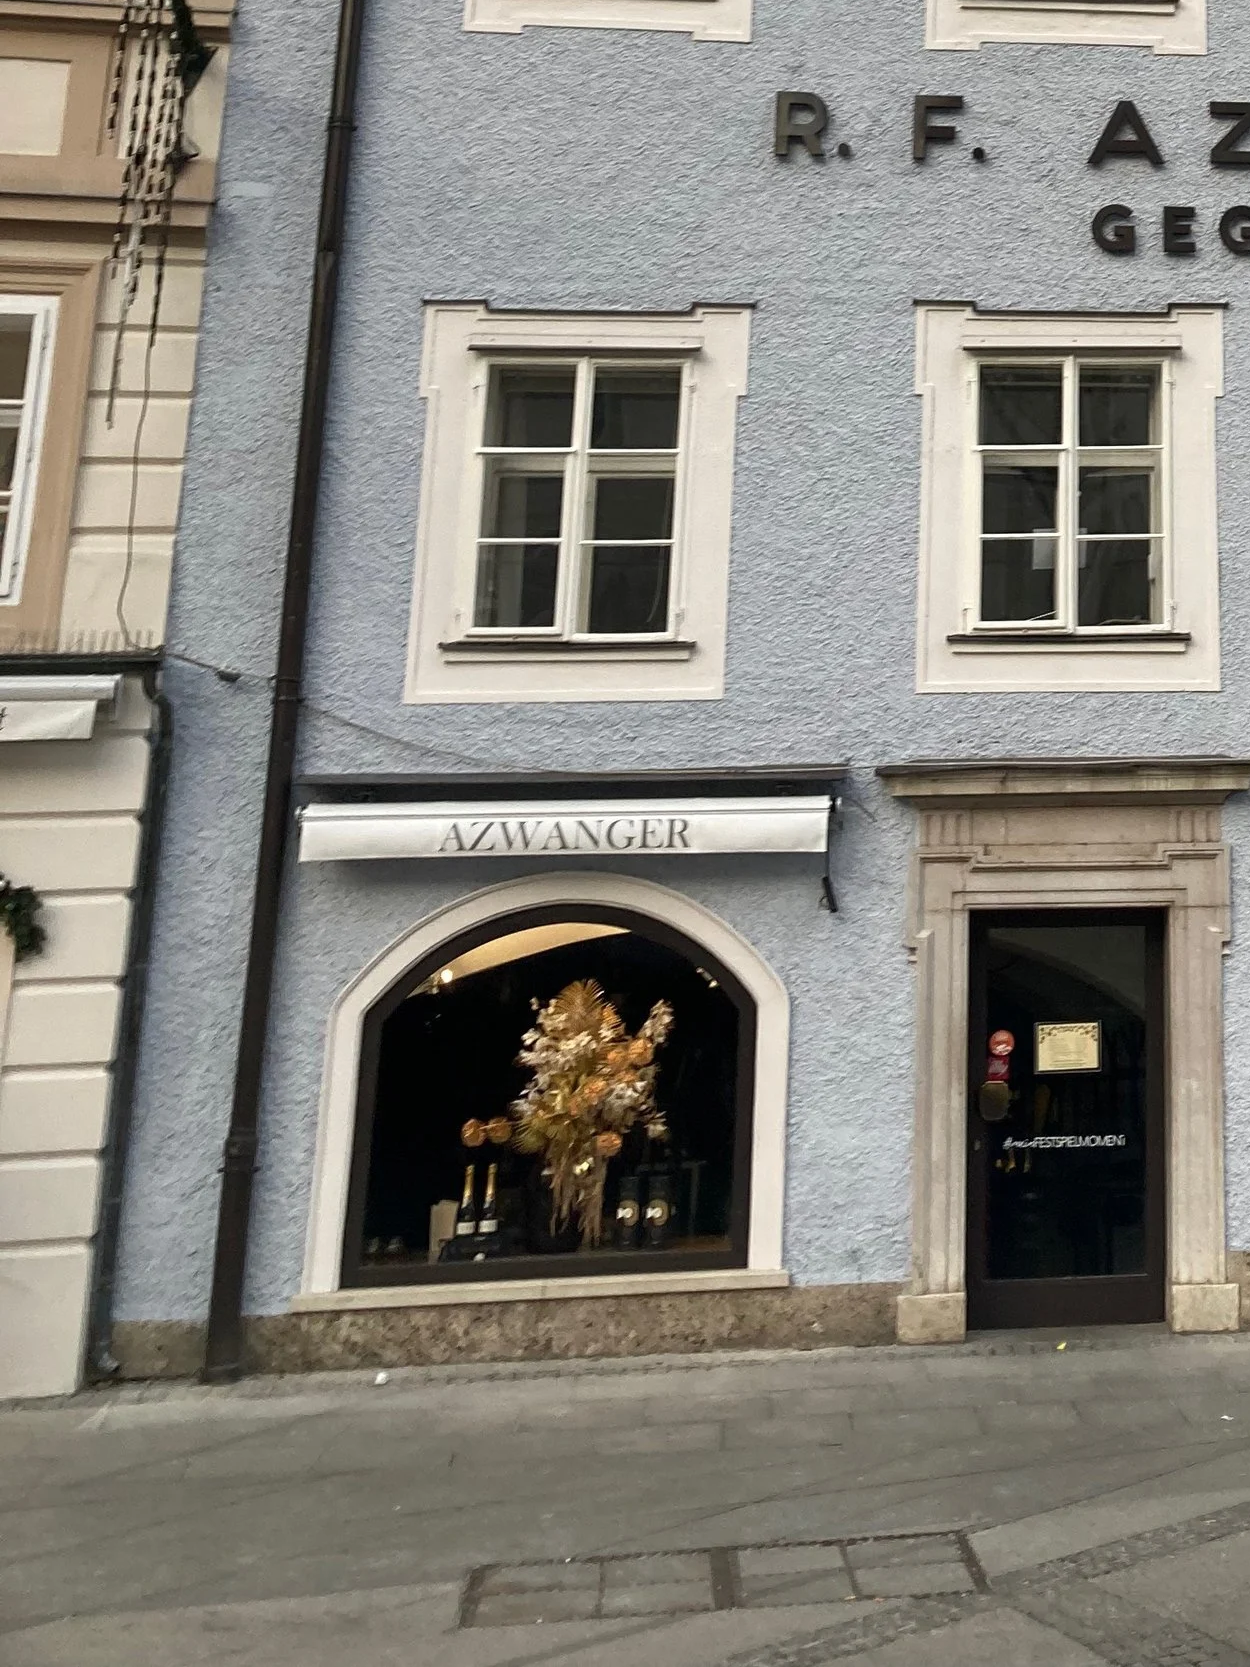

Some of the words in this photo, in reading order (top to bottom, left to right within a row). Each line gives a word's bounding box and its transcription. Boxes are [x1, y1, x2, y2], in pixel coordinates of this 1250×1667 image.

[774, 90, 854, 164] R.
[911, 94, 988, 168] F.
[437, 818, 692, 852] AZWANGER
